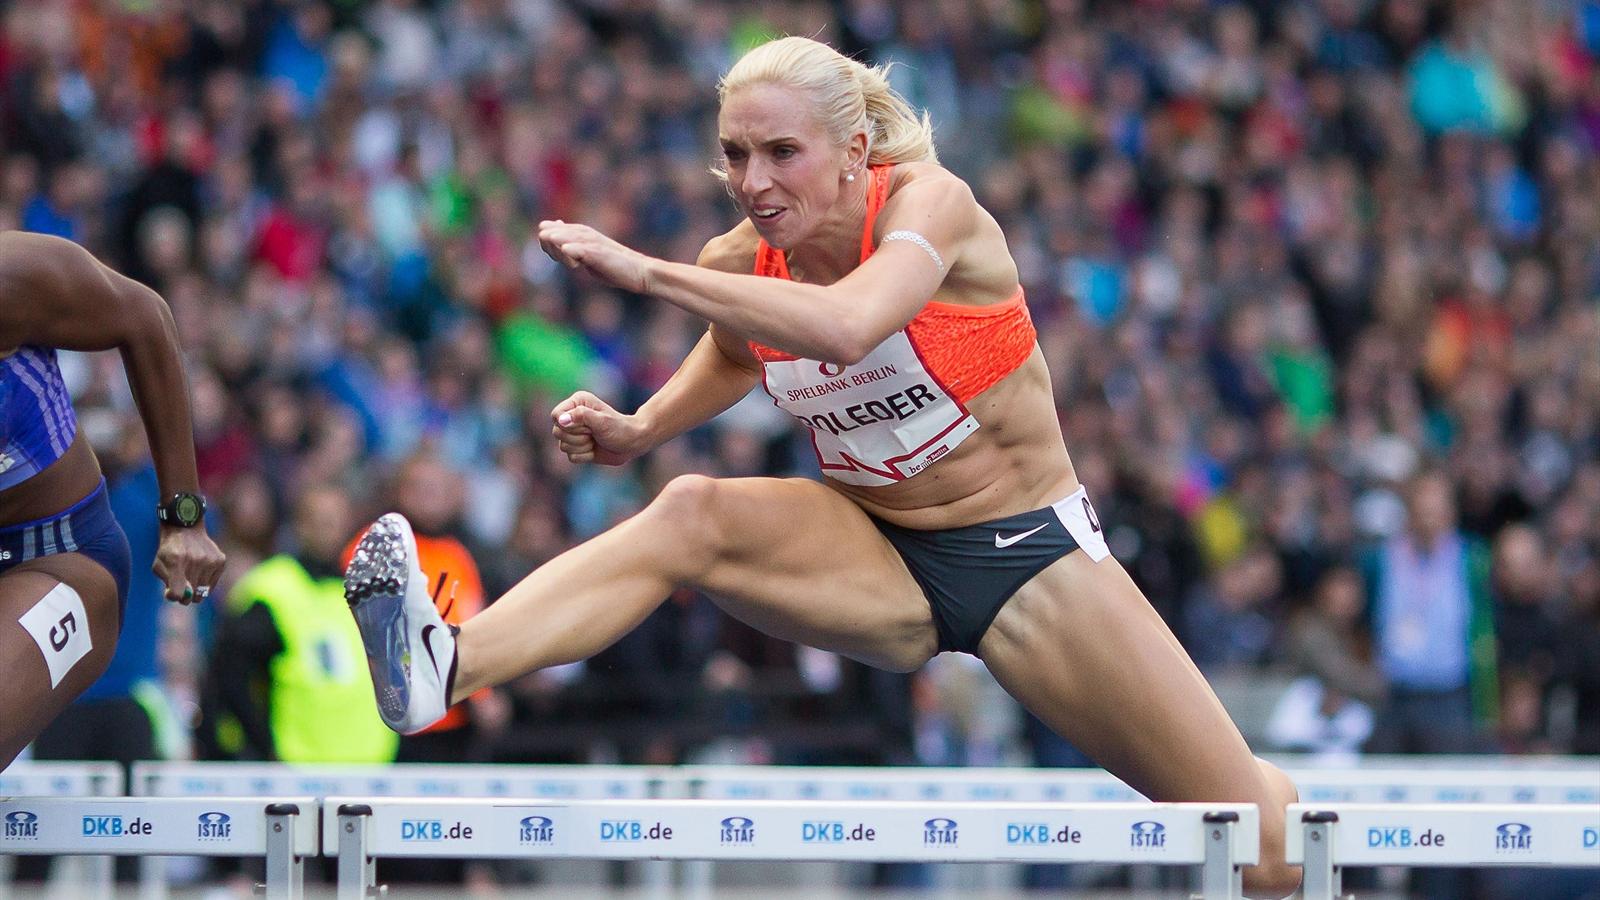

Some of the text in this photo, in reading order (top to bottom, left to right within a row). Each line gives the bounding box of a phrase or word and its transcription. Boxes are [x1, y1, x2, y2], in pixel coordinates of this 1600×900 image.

[787, 364, 898, 402] SPIELBANK BERLIN
[49, 611, 76, 653] 5
[5, 823, 38, 837] ISTAF
[82, 817, 152, 836] DKB.de
[198, 824, 231, 838] ISTAF
[401, 821, 473, 840] DKB.de
[520, 827, 553, 842] ISTAF
[600, 821, 673, 841] DKB.de
[720, 828, 755, 843] ISTAF
[802, 823, 876, 842] DKB.de
[1006, 825, 1082, 844] DKB.de
[924, 829, 959, 844] ISTAF
[1130, 831, 1166, 847] ISTAF
[1367, 828, 1445, 848] DKB.de
[1495, 833, 1532, 849] ISTAF
